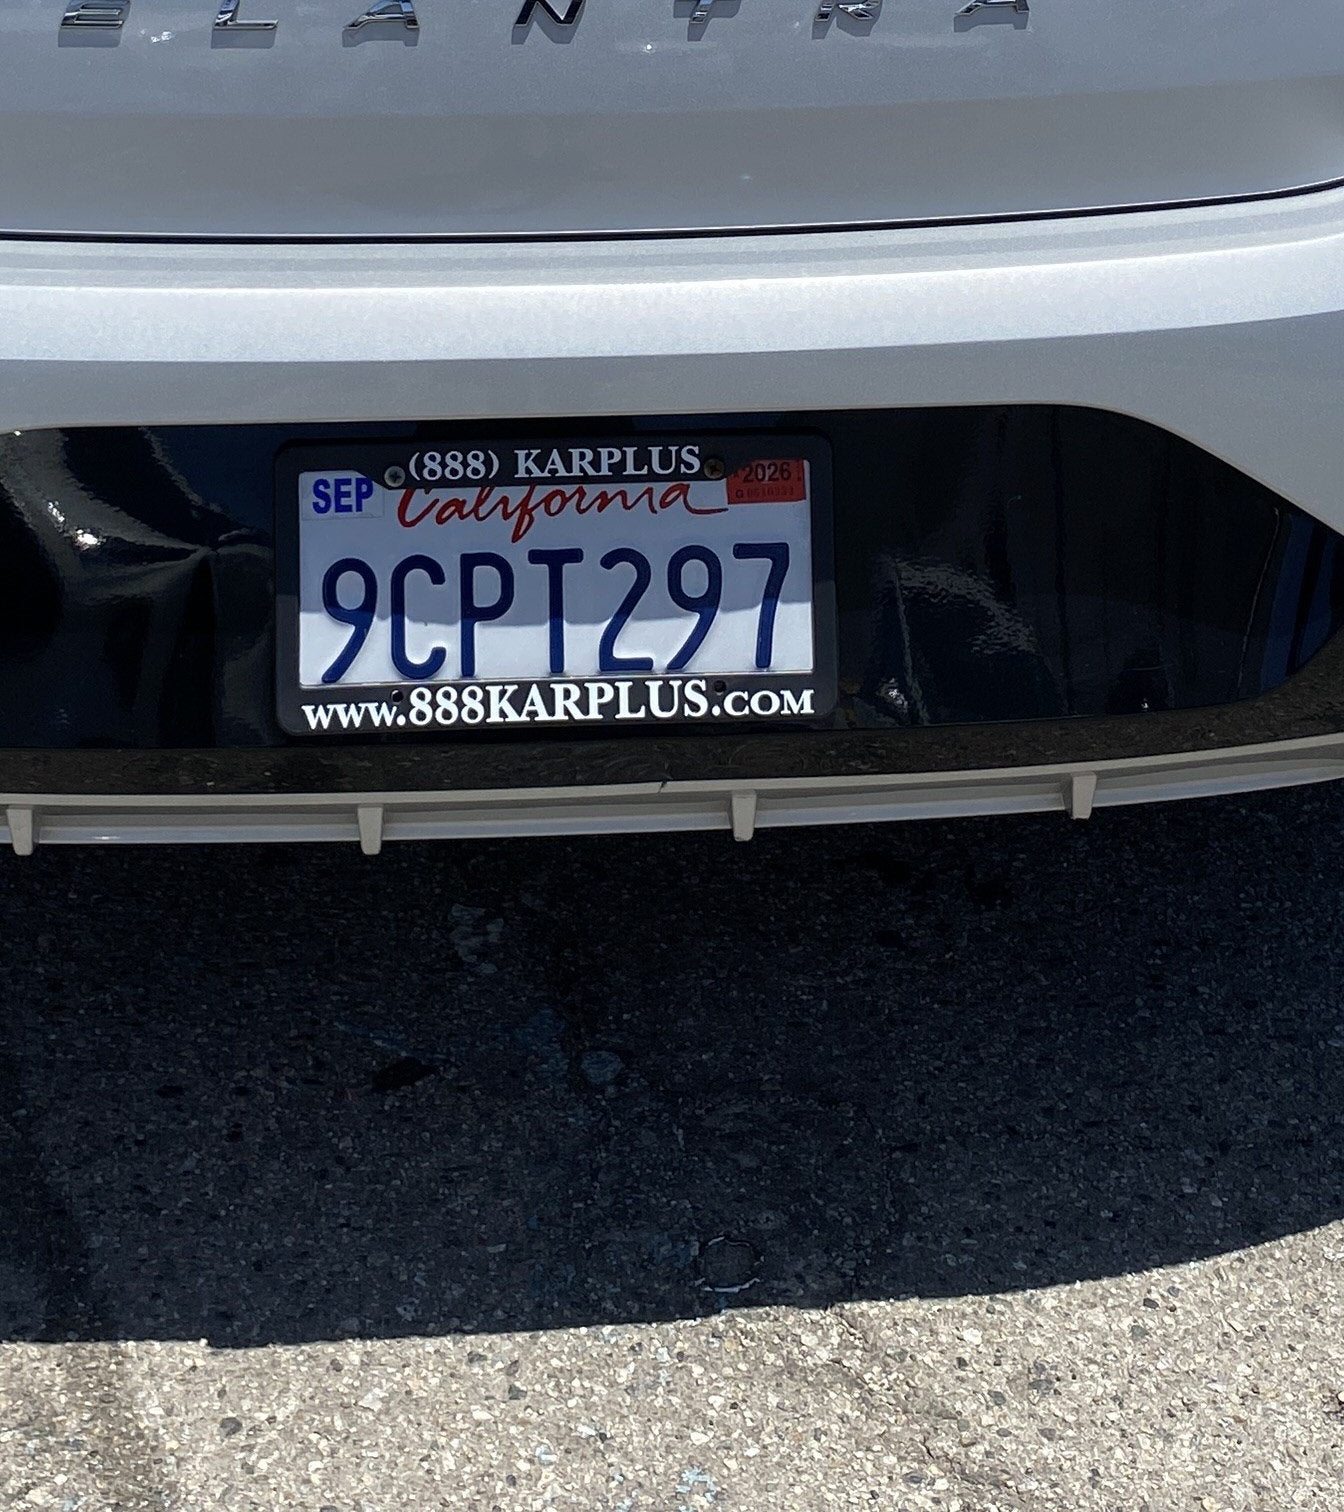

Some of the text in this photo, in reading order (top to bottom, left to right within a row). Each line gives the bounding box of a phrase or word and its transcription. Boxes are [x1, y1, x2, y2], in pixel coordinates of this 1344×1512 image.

[408, 445, 701, 481] (888) KARPLUS
[742, 461, 793, 485] 2026
[312, 478, 374, 515] SEP
[397, 484, 729, 544] California
[321, 542, 791, 684] 9CPT297
[301, 678, 815, 730] www.888KARPLUS.COM
